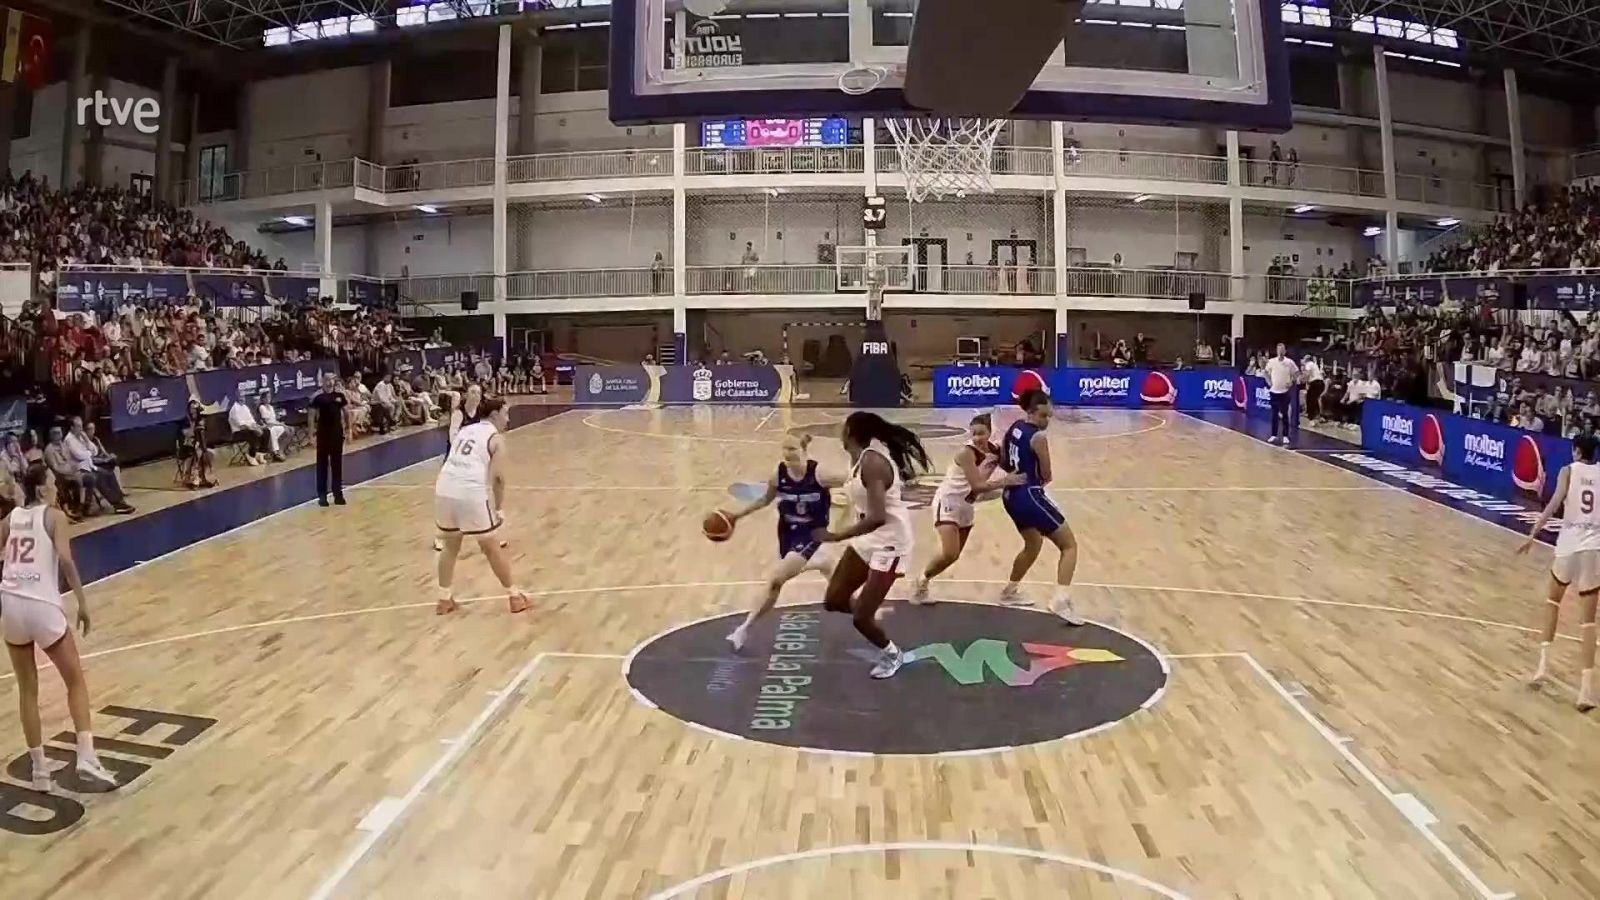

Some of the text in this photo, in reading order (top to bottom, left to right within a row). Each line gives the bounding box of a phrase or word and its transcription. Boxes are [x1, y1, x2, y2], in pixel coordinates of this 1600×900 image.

[862, 341, 888, 355] FIBA
[714, 379, 760, 388] Gobierno
[947, 374, 1000, 388] molten
[1079, 376, 1130, 389] molten
[714, 388, 769, 397] de Canarias
[1382, 415, 1414, 435] molten
[1464, 433, 1505, 459] molten
[1580, 489, 1594, 514] 9
[10, 537, 35, 564] 12
[773, 632, 820, 651] de
[766, 654, 817, 671] La
[750, 676, 813, 730] Palma
